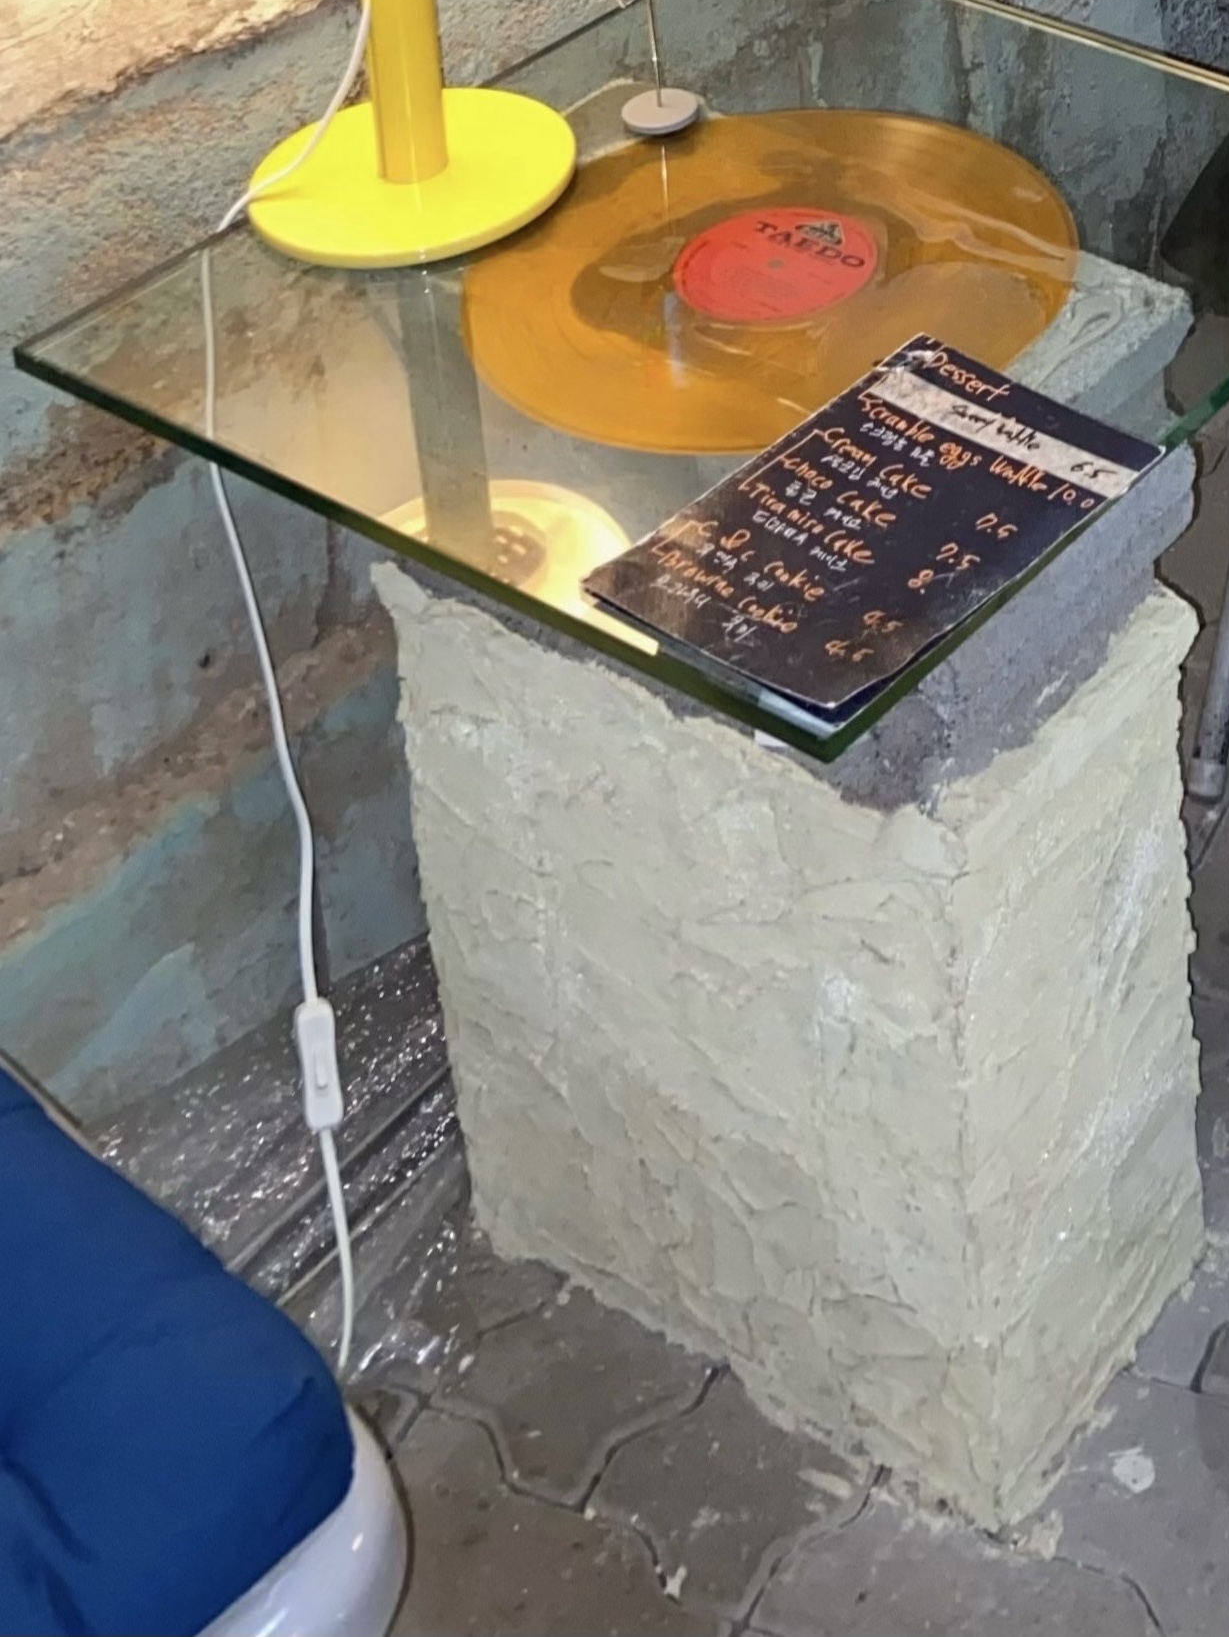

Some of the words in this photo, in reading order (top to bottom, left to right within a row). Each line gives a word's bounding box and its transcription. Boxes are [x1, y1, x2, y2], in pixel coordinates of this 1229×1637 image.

[925, 346, 1010, 401] Dessert
[879, 464, 932, 498] Cake
[836, 490, 896, 528] Cake
[824, 530, 876, 564] Cake
[764, 561, 825, 602] Cookie
